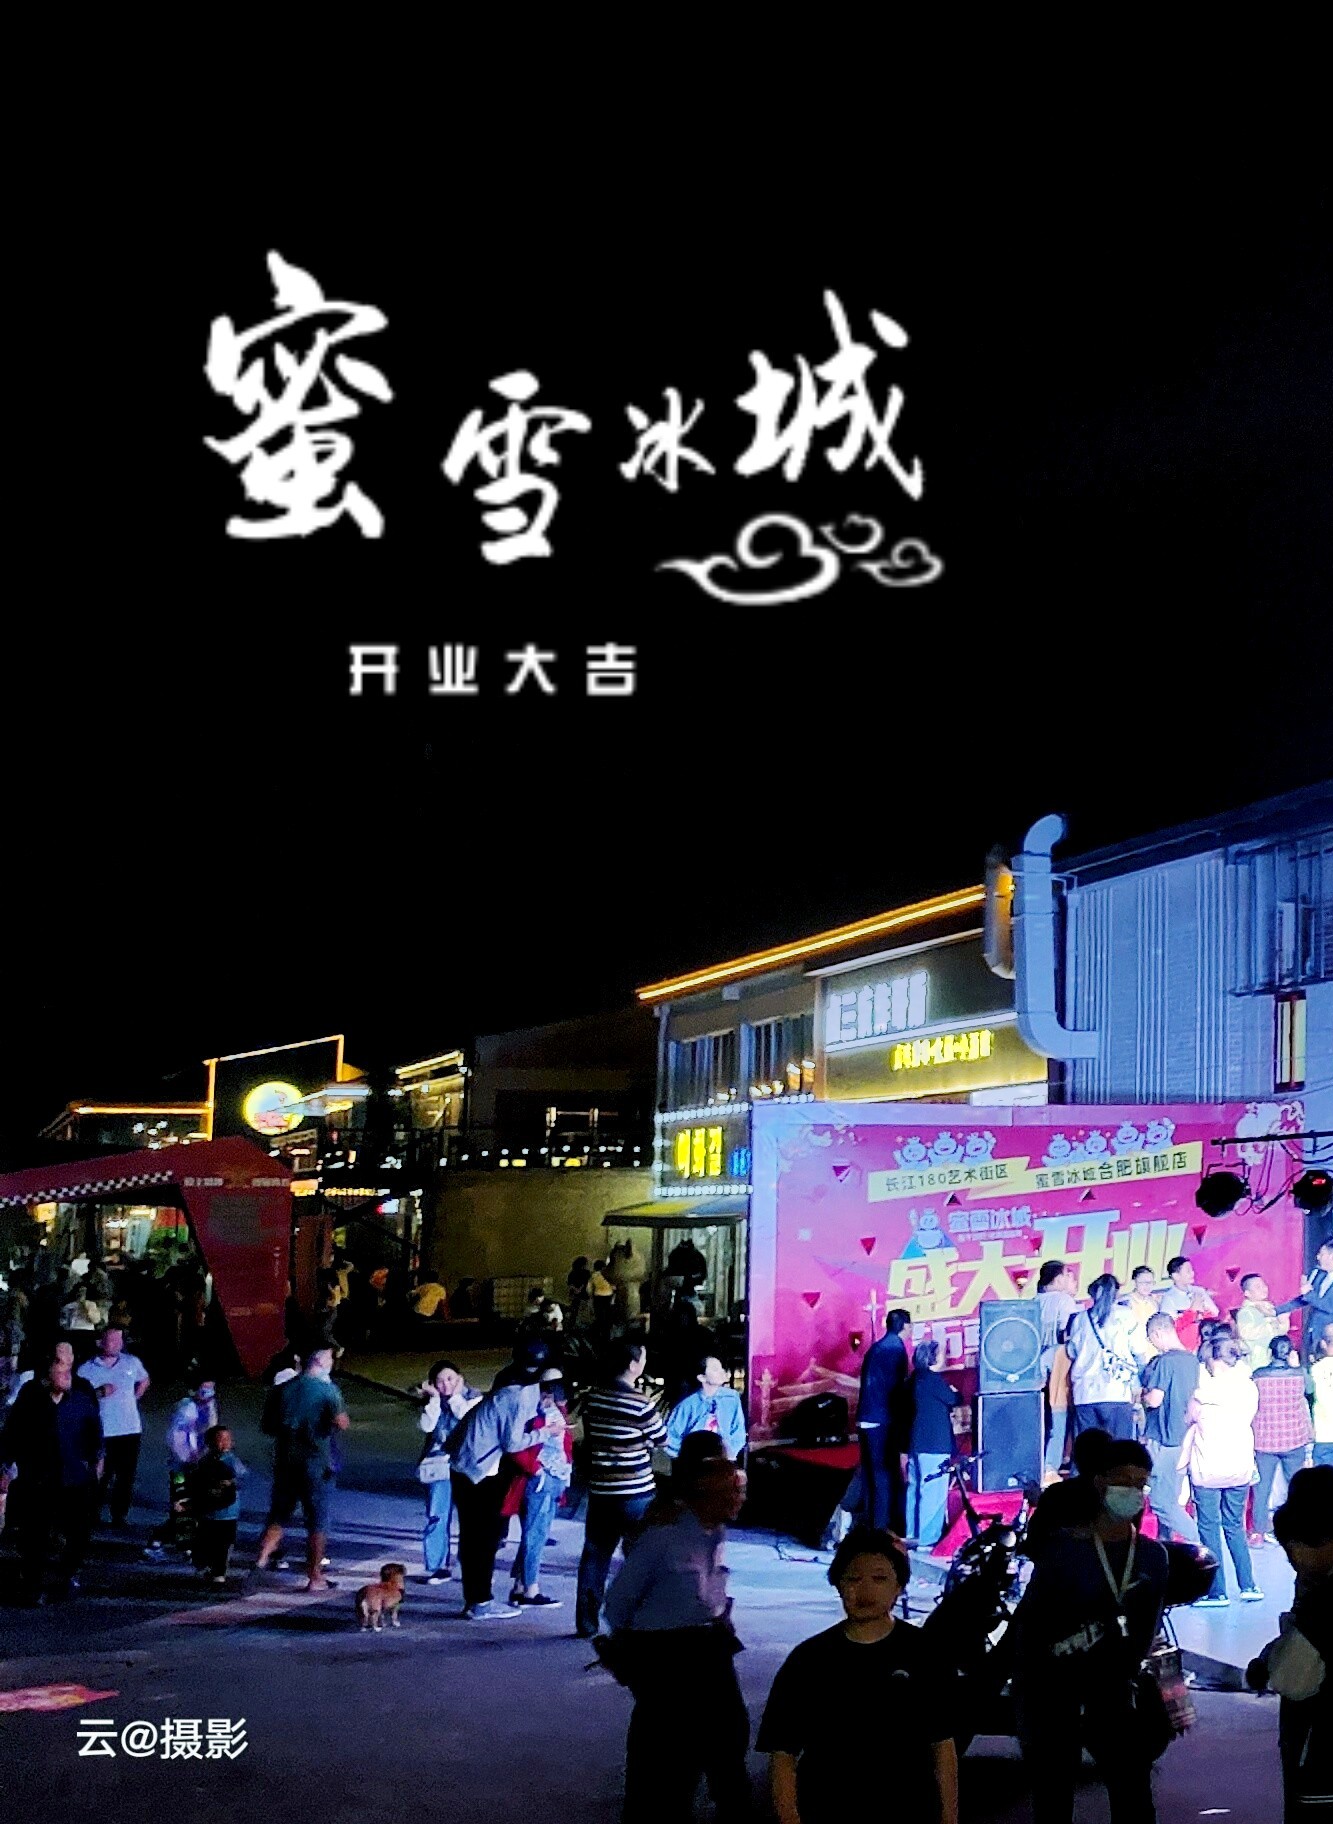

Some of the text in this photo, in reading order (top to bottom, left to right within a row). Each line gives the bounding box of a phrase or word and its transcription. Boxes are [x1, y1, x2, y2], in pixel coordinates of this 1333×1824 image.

[885, 1150, 1188, 1192] 长江180艺术街区 蜜雪冰城合肥旗舰店
[885, 1209, 1189, 1322] 盛大开业
